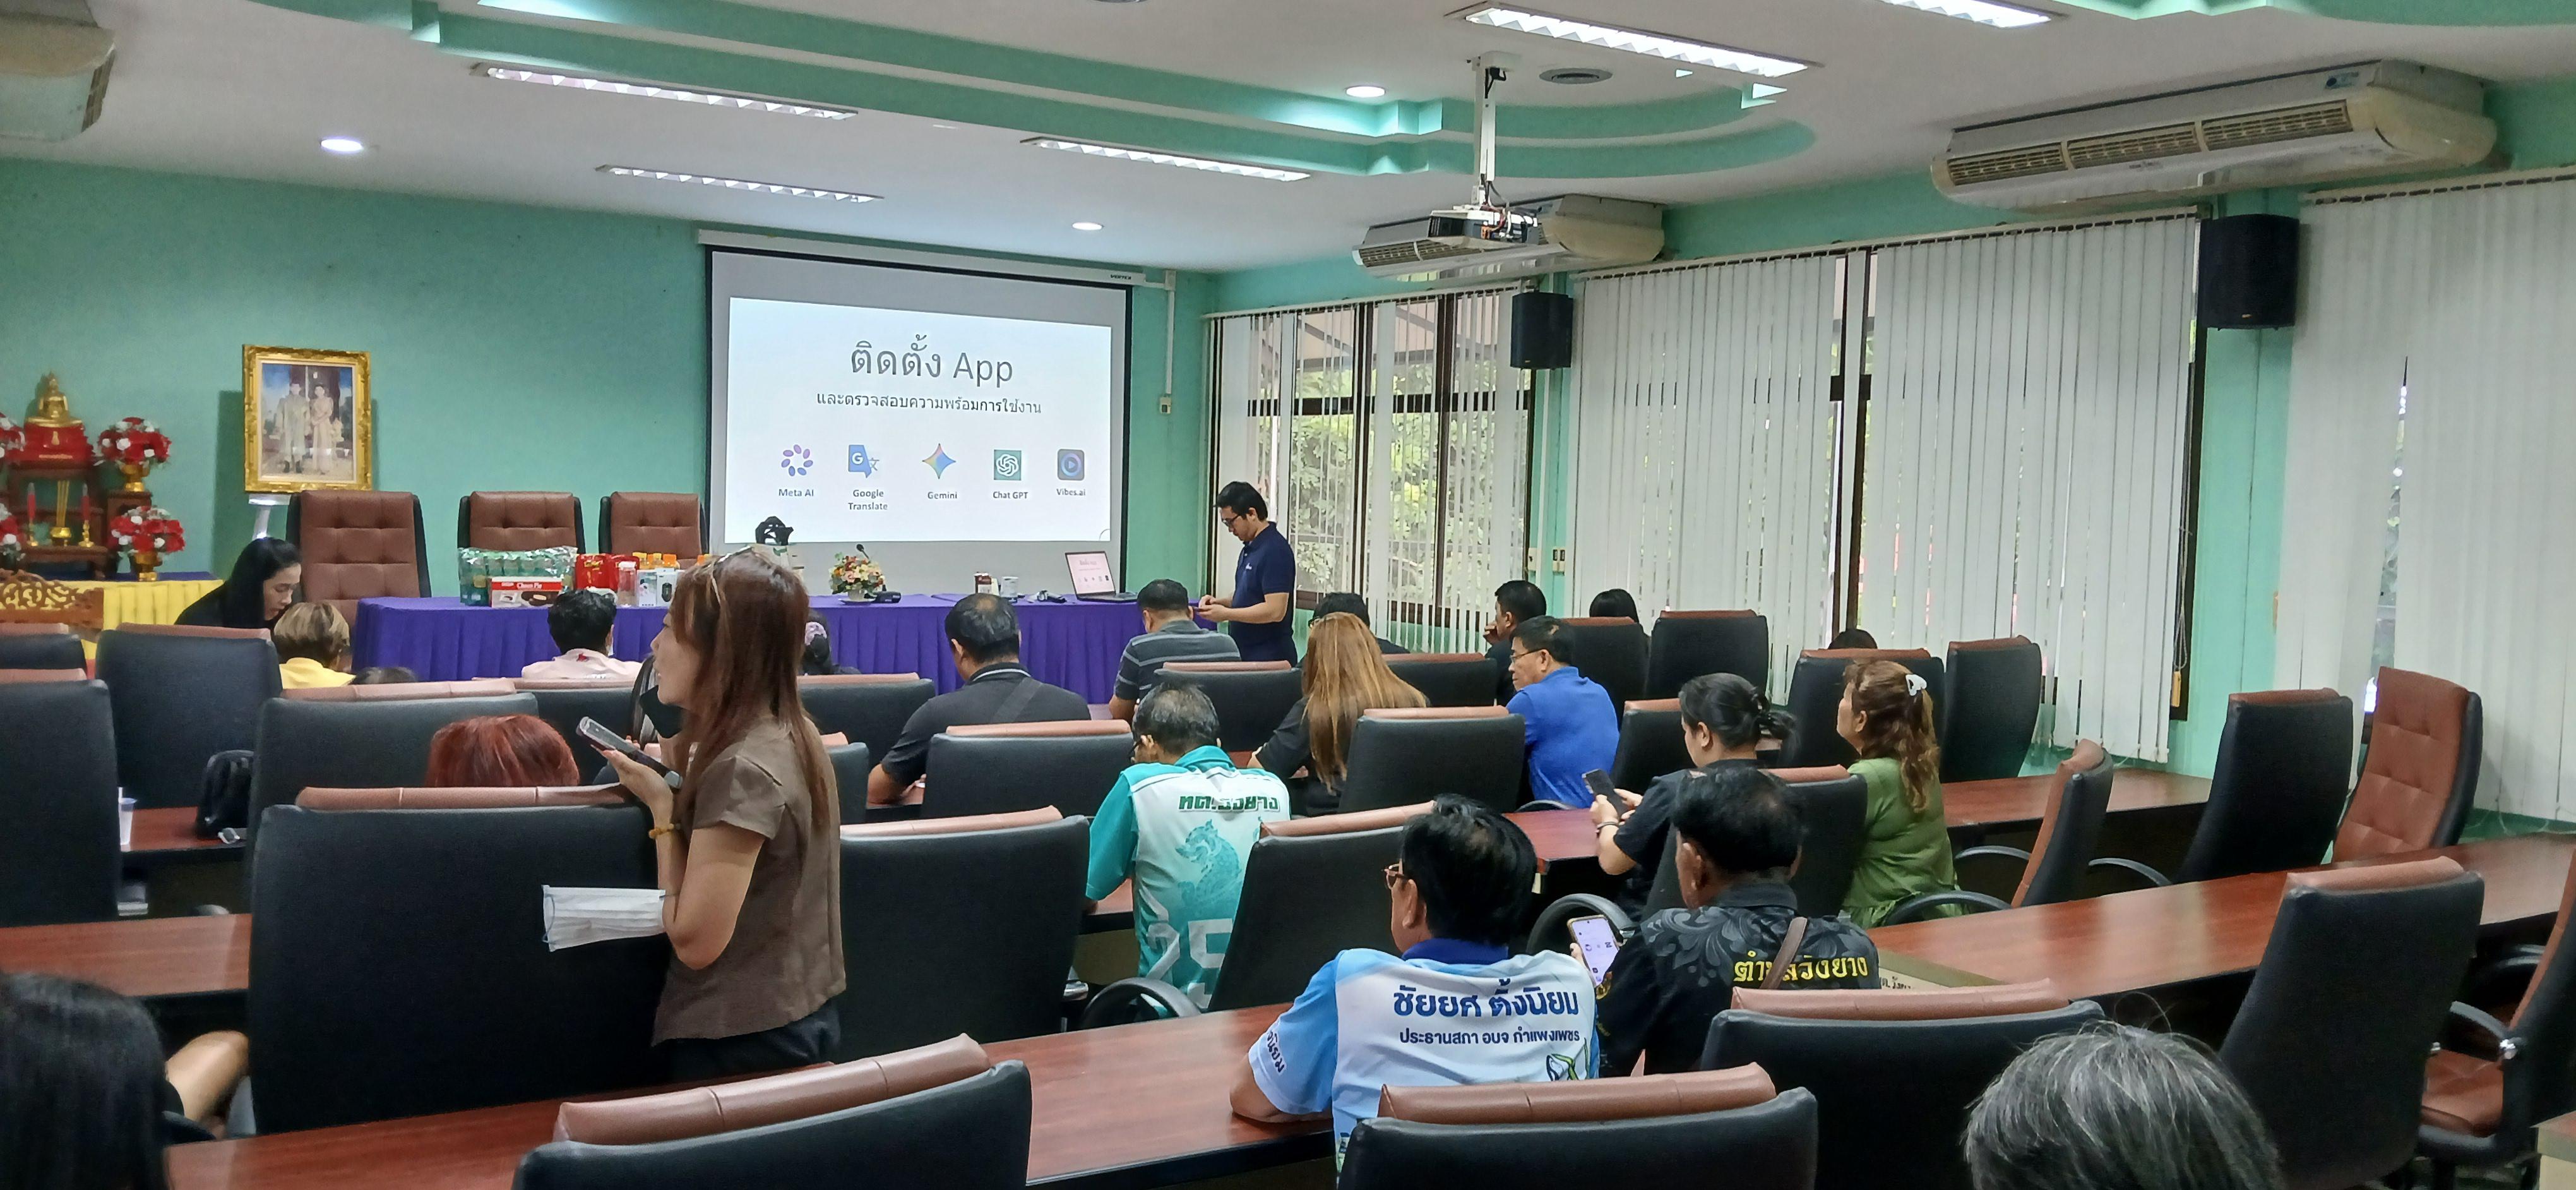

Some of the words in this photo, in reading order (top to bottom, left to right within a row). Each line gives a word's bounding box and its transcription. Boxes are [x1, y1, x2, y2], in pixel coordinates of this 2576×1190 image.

[851, 334, 941, 378] ติดตั้ง
[953, 352, 1013, 388] App
[816, 392, 1042, 414] และตรวจสอบความพร้อมการใช้งาน
[778, 488, 802, 497] Meta
[804, 489, 814, 497] AI
[852, 490, 885, 499] Google
[927, 491, 958, 500] Gemini
[993, 491, 1011, 499] Chat
[1012, 491, 1029, 500] GPT
[1056, 488, 1087, 496] Vibes.ai
[848, 502, 888, 510] Translate
[1393, 984, 1482, 1017] ชัยยศ
[1399, 1027, 1479, 1044] ประธานสภา
[1482, 1031, 1509, 1042] อบจ
[1513, 1026, 1580, 1043] กำแพงเพชร
